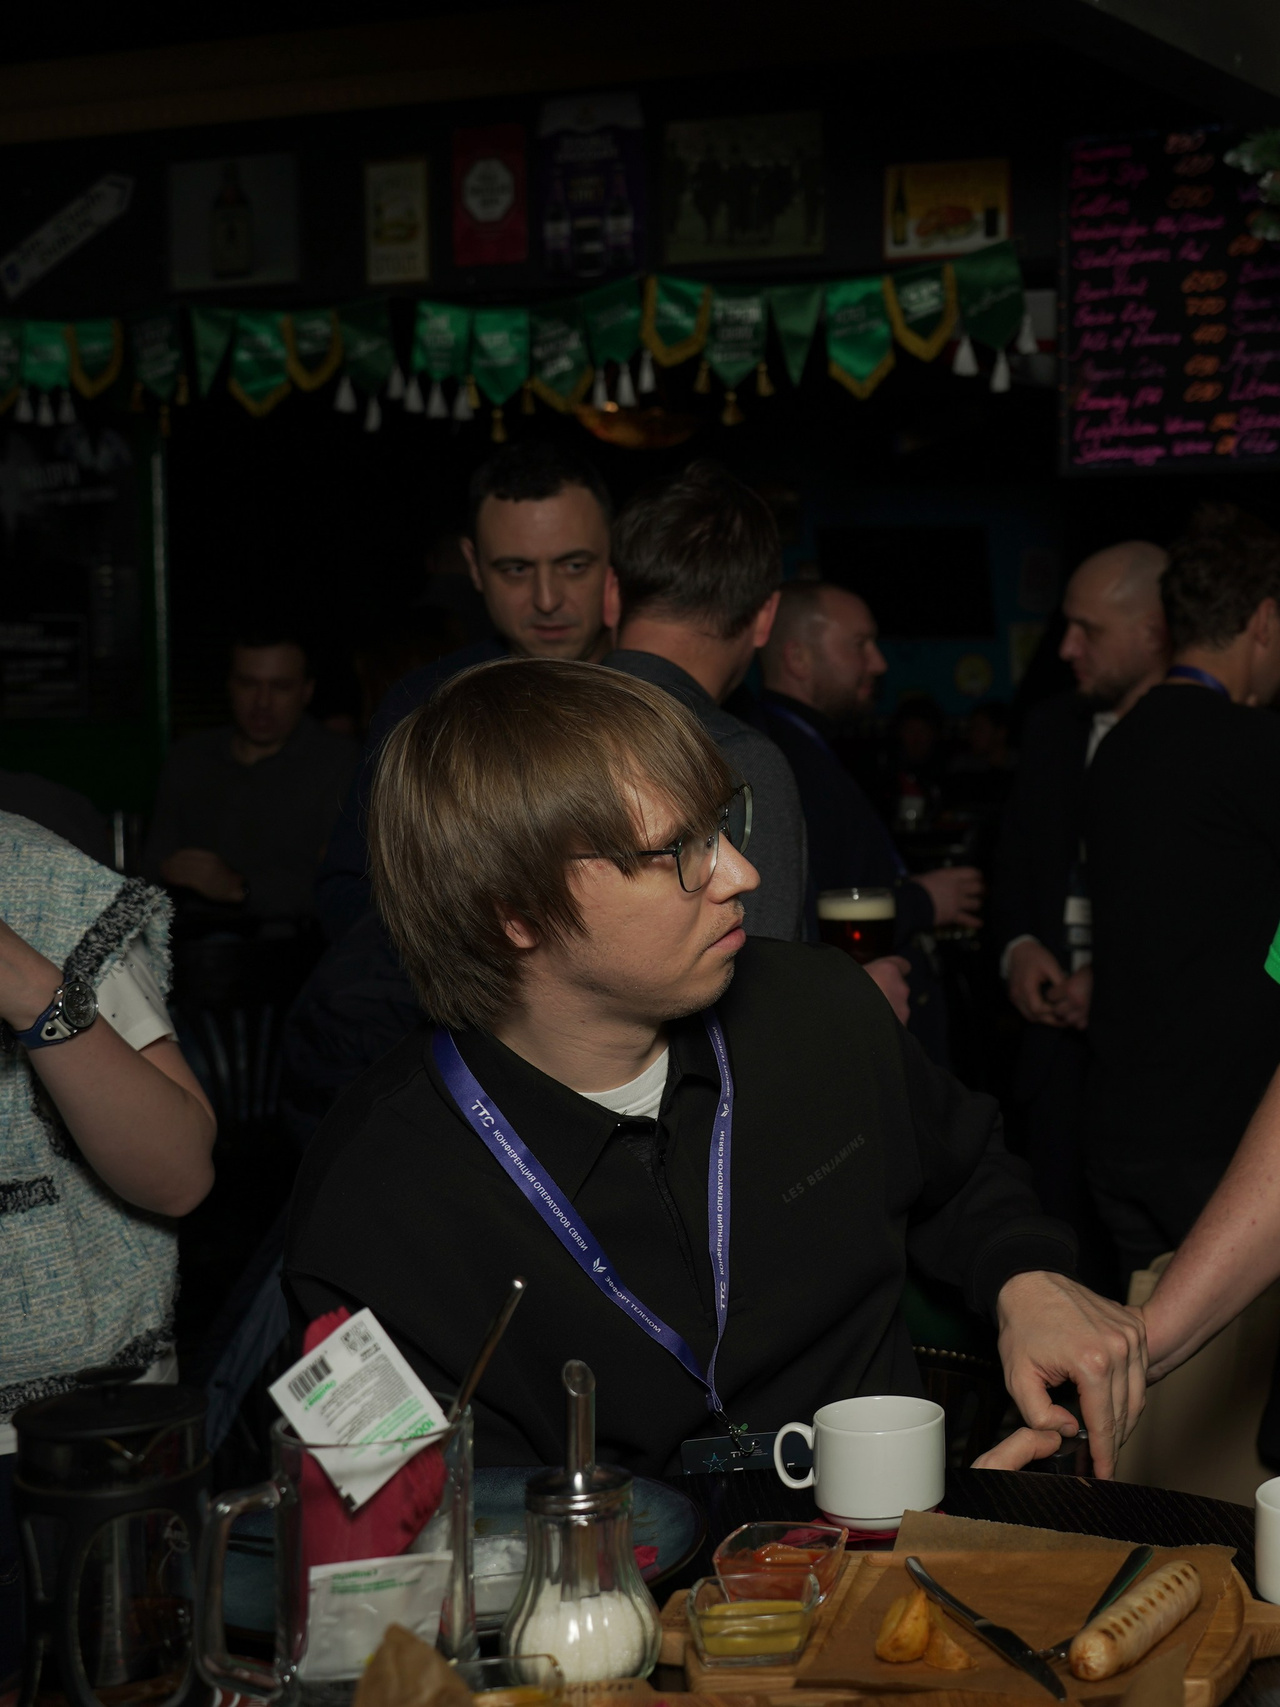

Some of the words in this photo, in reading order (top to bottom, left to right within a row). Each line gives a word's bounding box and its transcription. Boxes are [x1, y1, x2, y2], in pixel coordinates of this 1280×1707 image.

[718, 1130, 726, 1158] СВЯЗИ
[781, 1181, 805, 1204] LES
[806, 1133, 866, 1187] BENJAMINS
[716, 1157, 724, 1213] ОПЕРАТОРОВ
[492, 1129, 537, 1183] КОНФЕРЕНЦИЯ
[533, 1181, 571, 1229] ОПЕРАТОРОВ
[568, 1227, 588, 1252] СВЯЗИ
[604, 1275, 631, 1304] ЭФФОРТ
[630, 1302, 662, 1333] ТЕЛЕКОМ
[716, 1215, 725, 1276] КОНФЕРЕНЦИЯ
